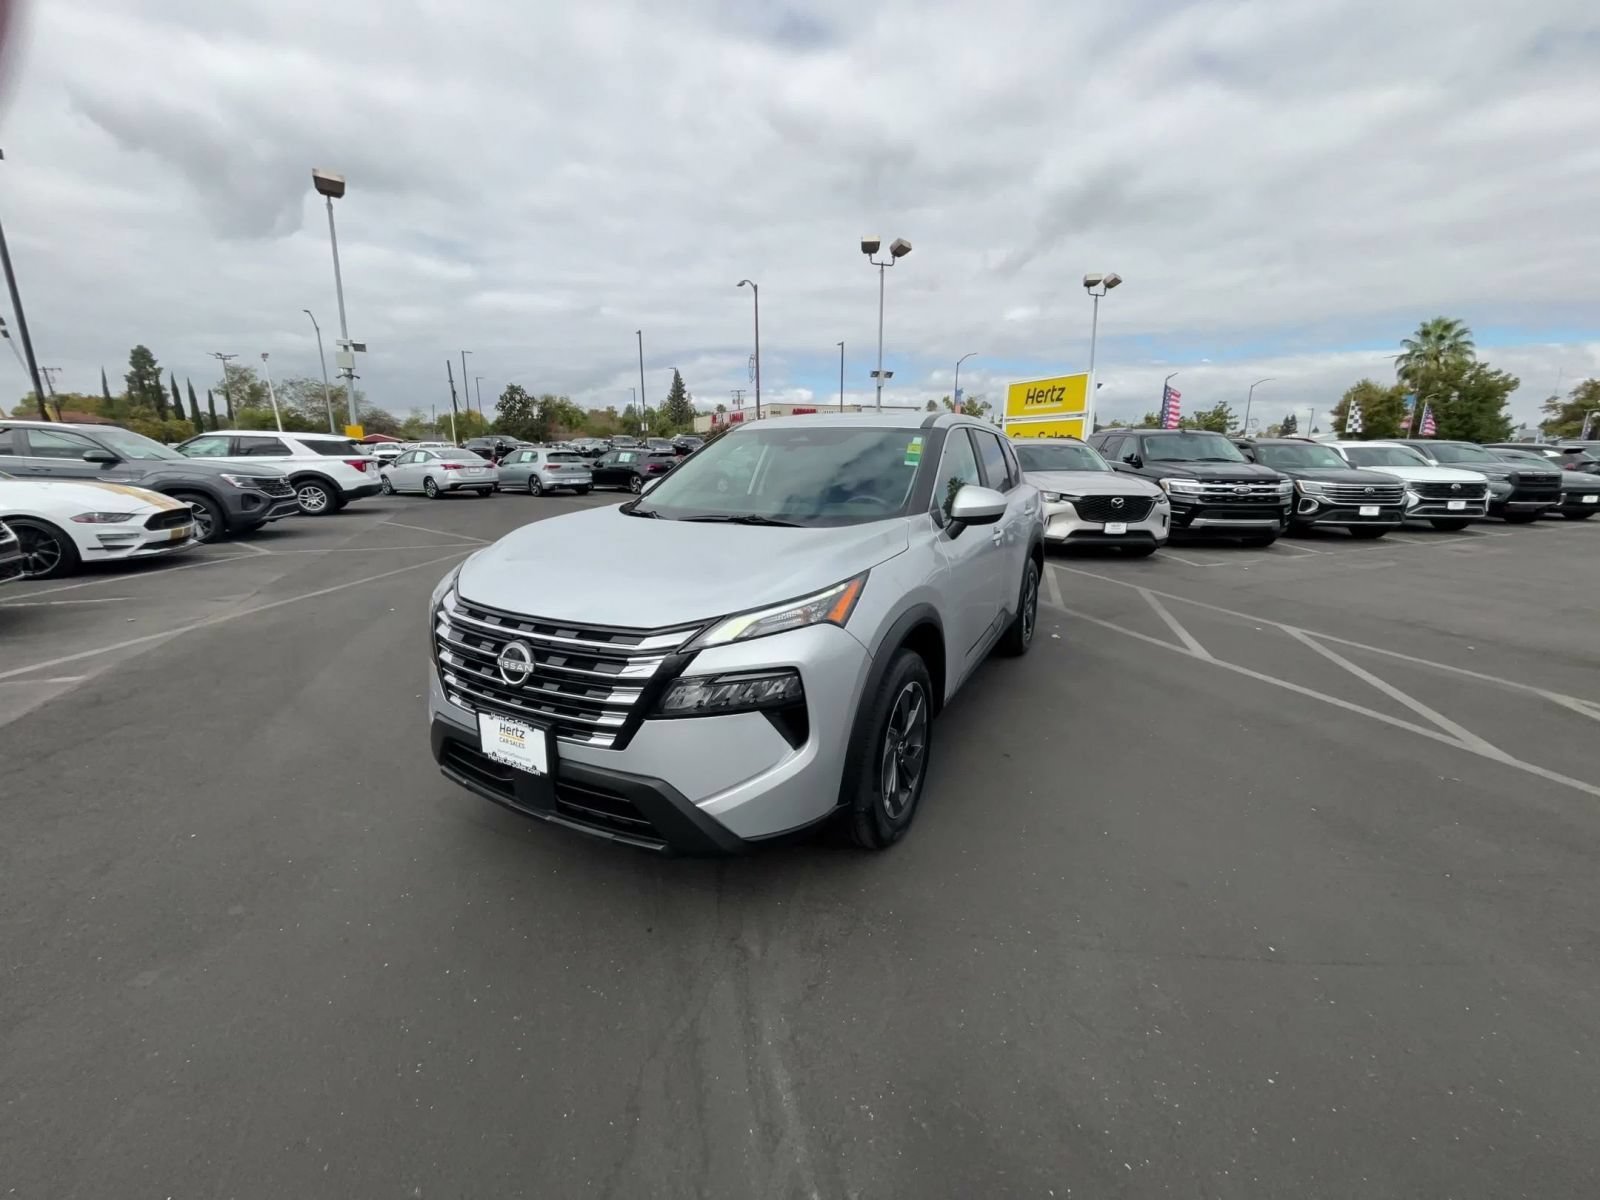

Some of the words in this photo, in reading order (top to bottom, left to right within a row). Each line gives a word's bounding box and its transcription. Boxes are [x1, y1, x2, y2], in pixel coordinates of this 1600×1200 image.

[1025, 385, 1066, 405] Hertz
[497, 657, 533, 672] NISSAN
[499, 722, 525, 739] Hertz
[499, 737, 510, 745] CAR
[510, 739, 525, 749] SALES
